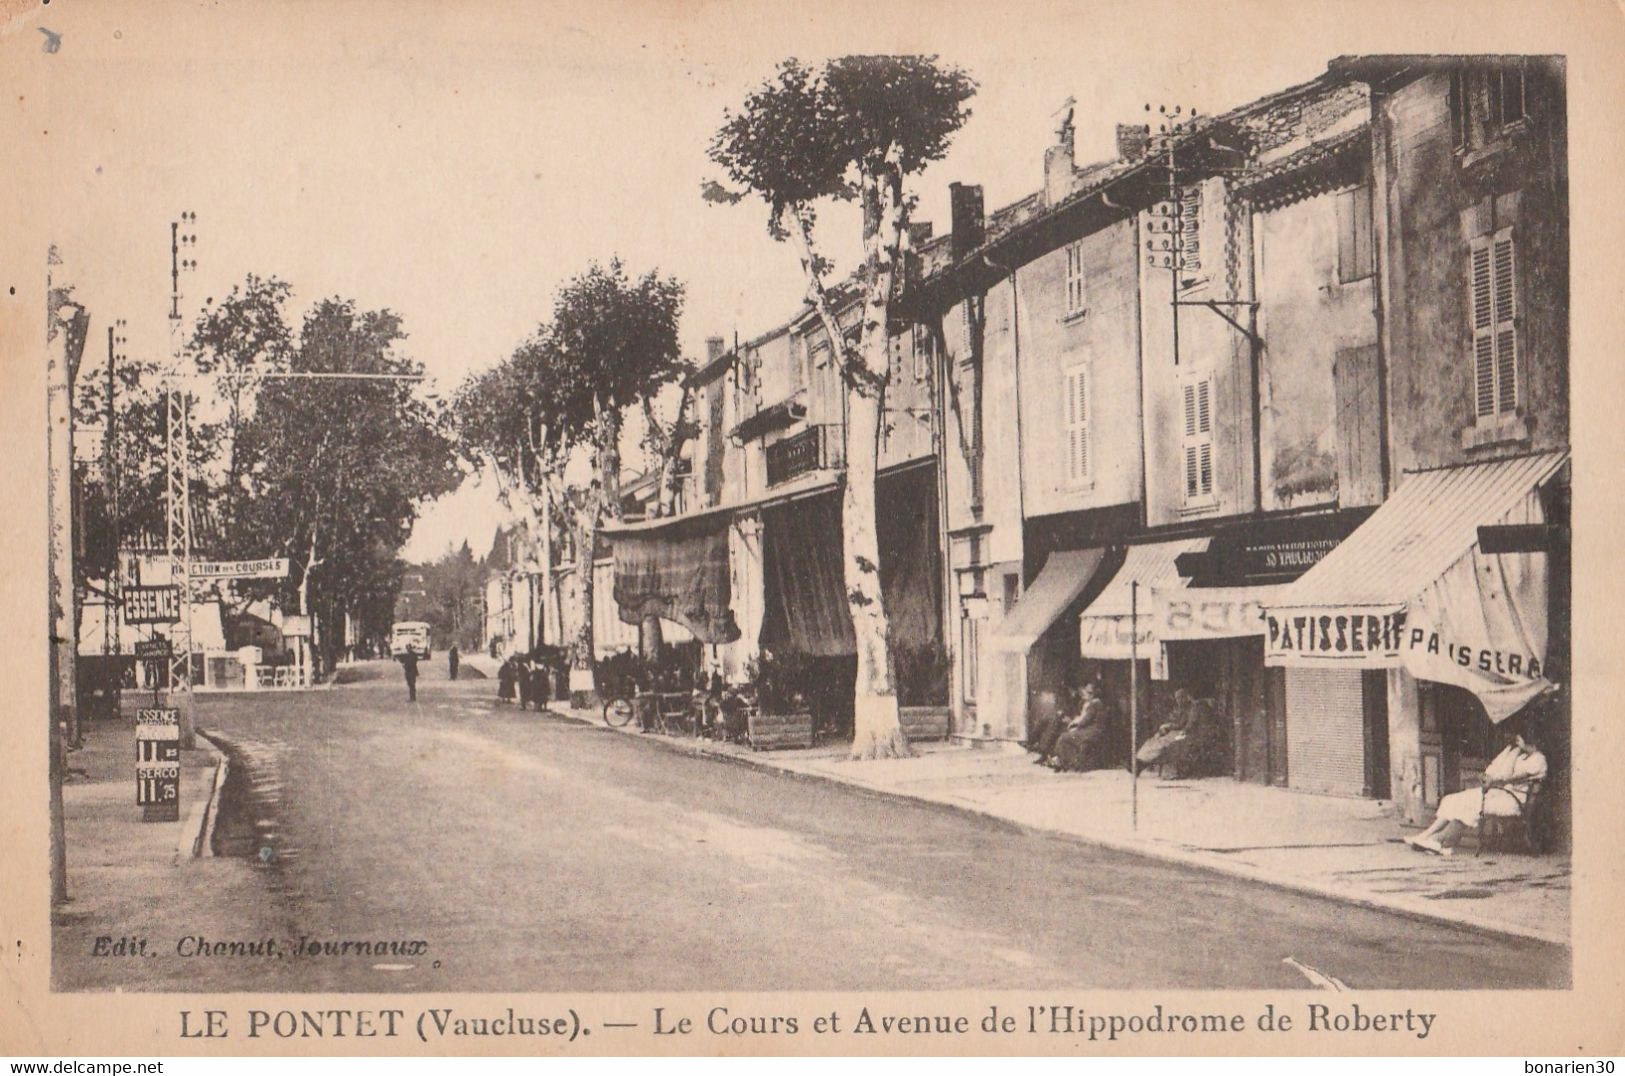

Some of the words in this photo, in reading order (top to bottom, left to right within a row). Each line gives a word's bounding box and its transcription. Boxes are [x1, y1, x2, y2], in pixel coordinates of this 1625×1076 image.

[235, 560, 281, 573] COURSES
[124, 589, 179, 619] ESSENCE
[1267, 614, 1407, 652] PATISSERIE
[136, 708, 178, 722] ESSENCE
[138, 768, 178, 779] SERCO
